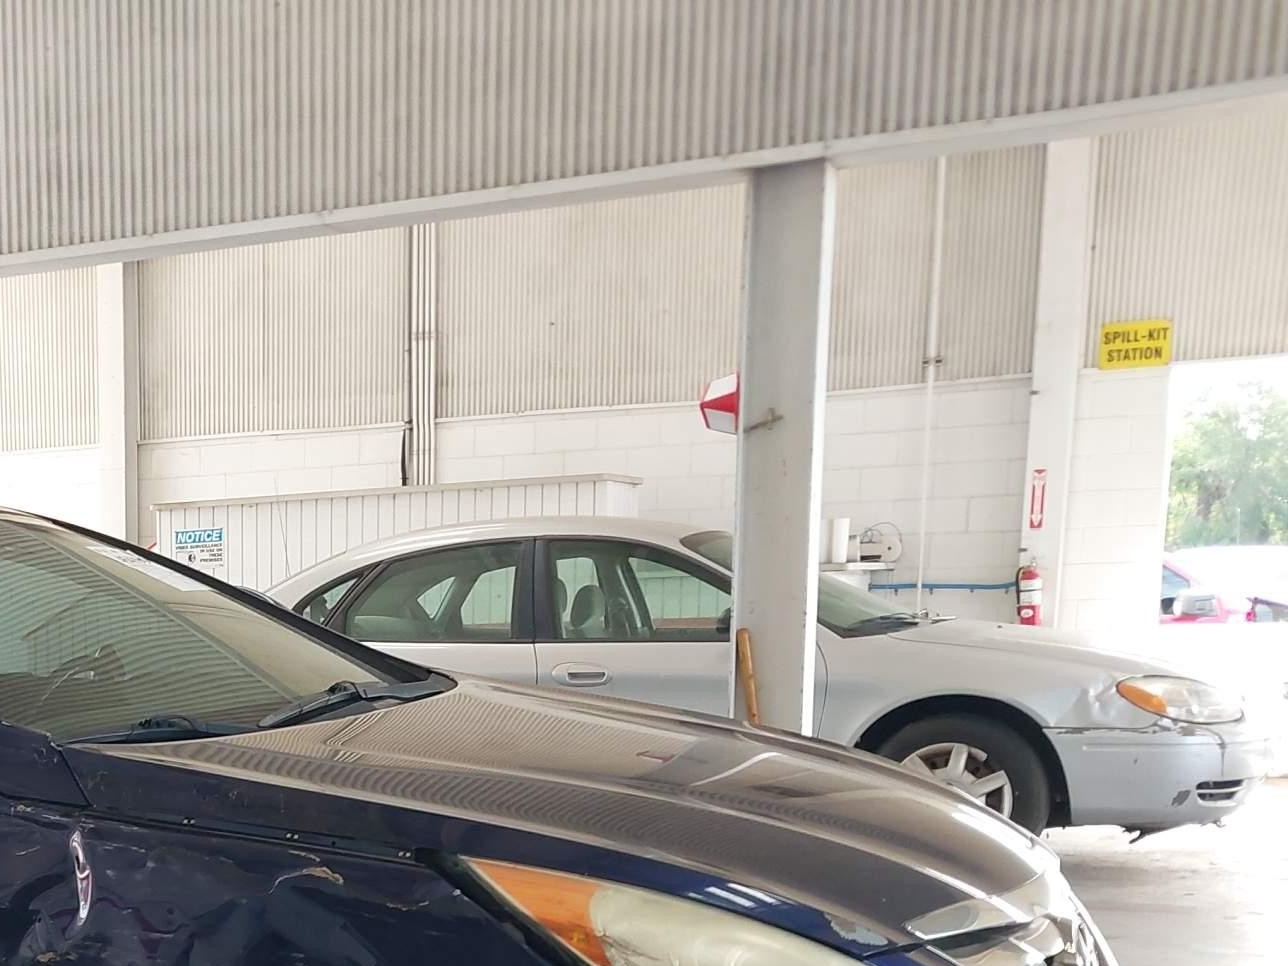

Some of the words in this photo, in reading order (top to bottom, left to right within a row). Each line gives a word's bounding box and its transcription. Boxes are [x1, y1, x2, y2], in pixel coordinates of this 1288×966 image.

[1103, 327, 1170, 345] SPILL-KIT
[1106, 346, 1163, 362] STATION
[177, 530, 220, 543] NOTICE
